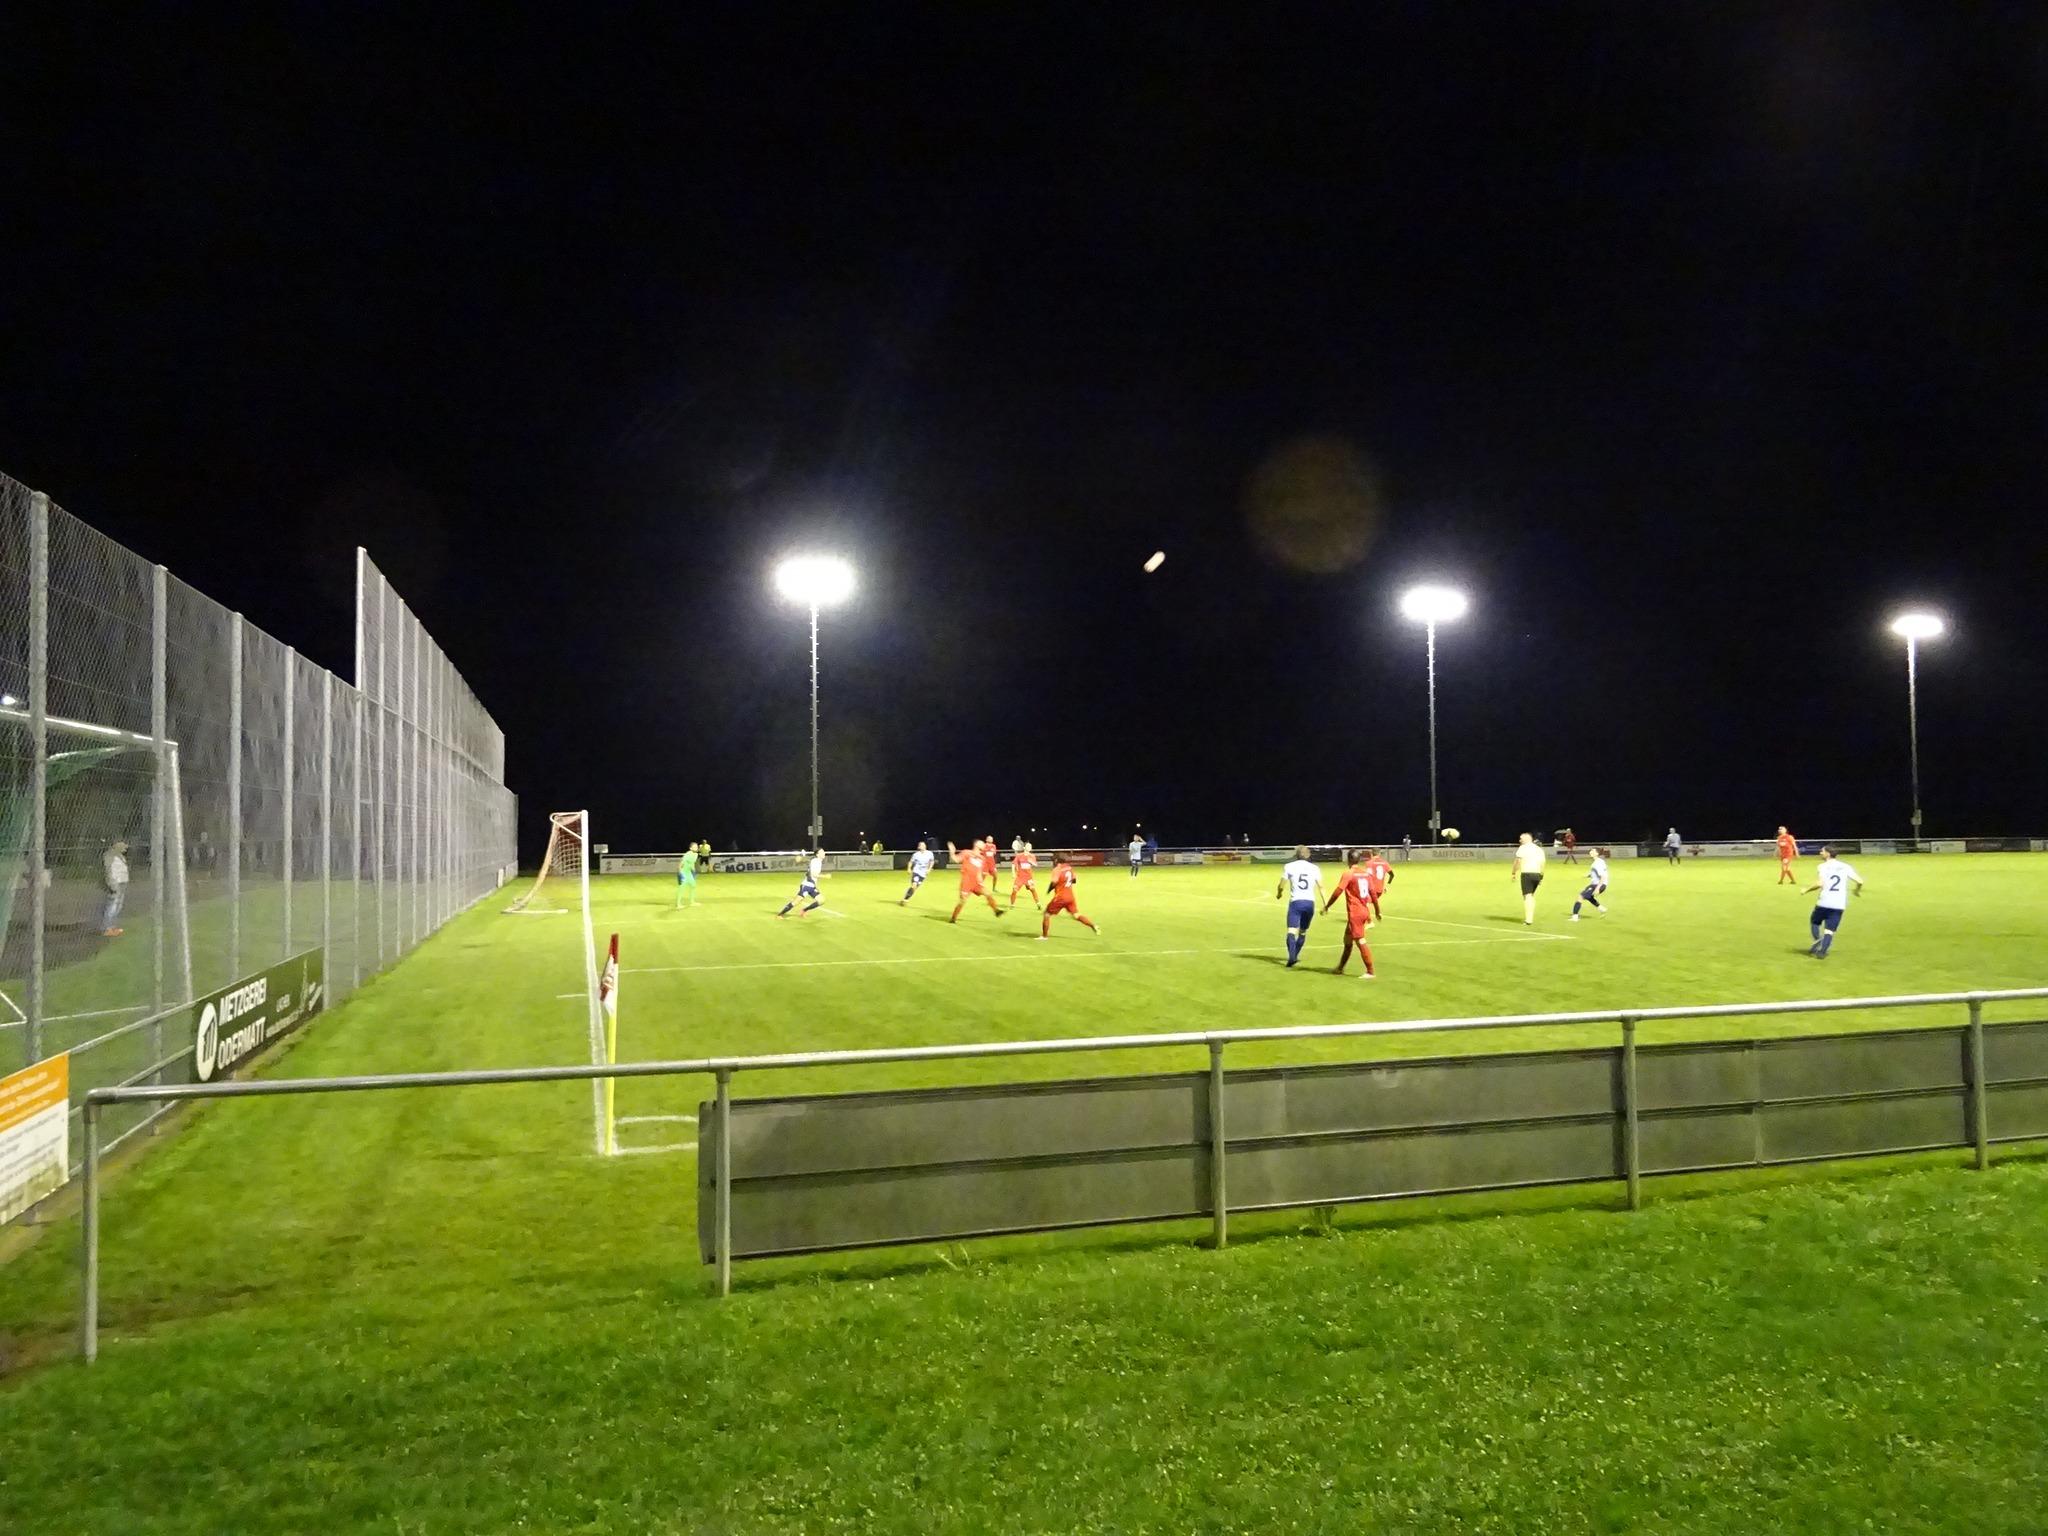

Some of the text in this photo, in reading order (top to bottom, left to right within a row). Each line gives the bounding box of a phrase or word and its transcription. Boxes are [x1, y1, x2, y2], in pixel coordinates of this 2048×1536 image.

[1298, 874, 1309, 890] 5
[1829, 875, 1841, 891] 2
[219, 977, 267, 1026] METZGEREI
[217, 1016, 266, 1070] ODERMATT
